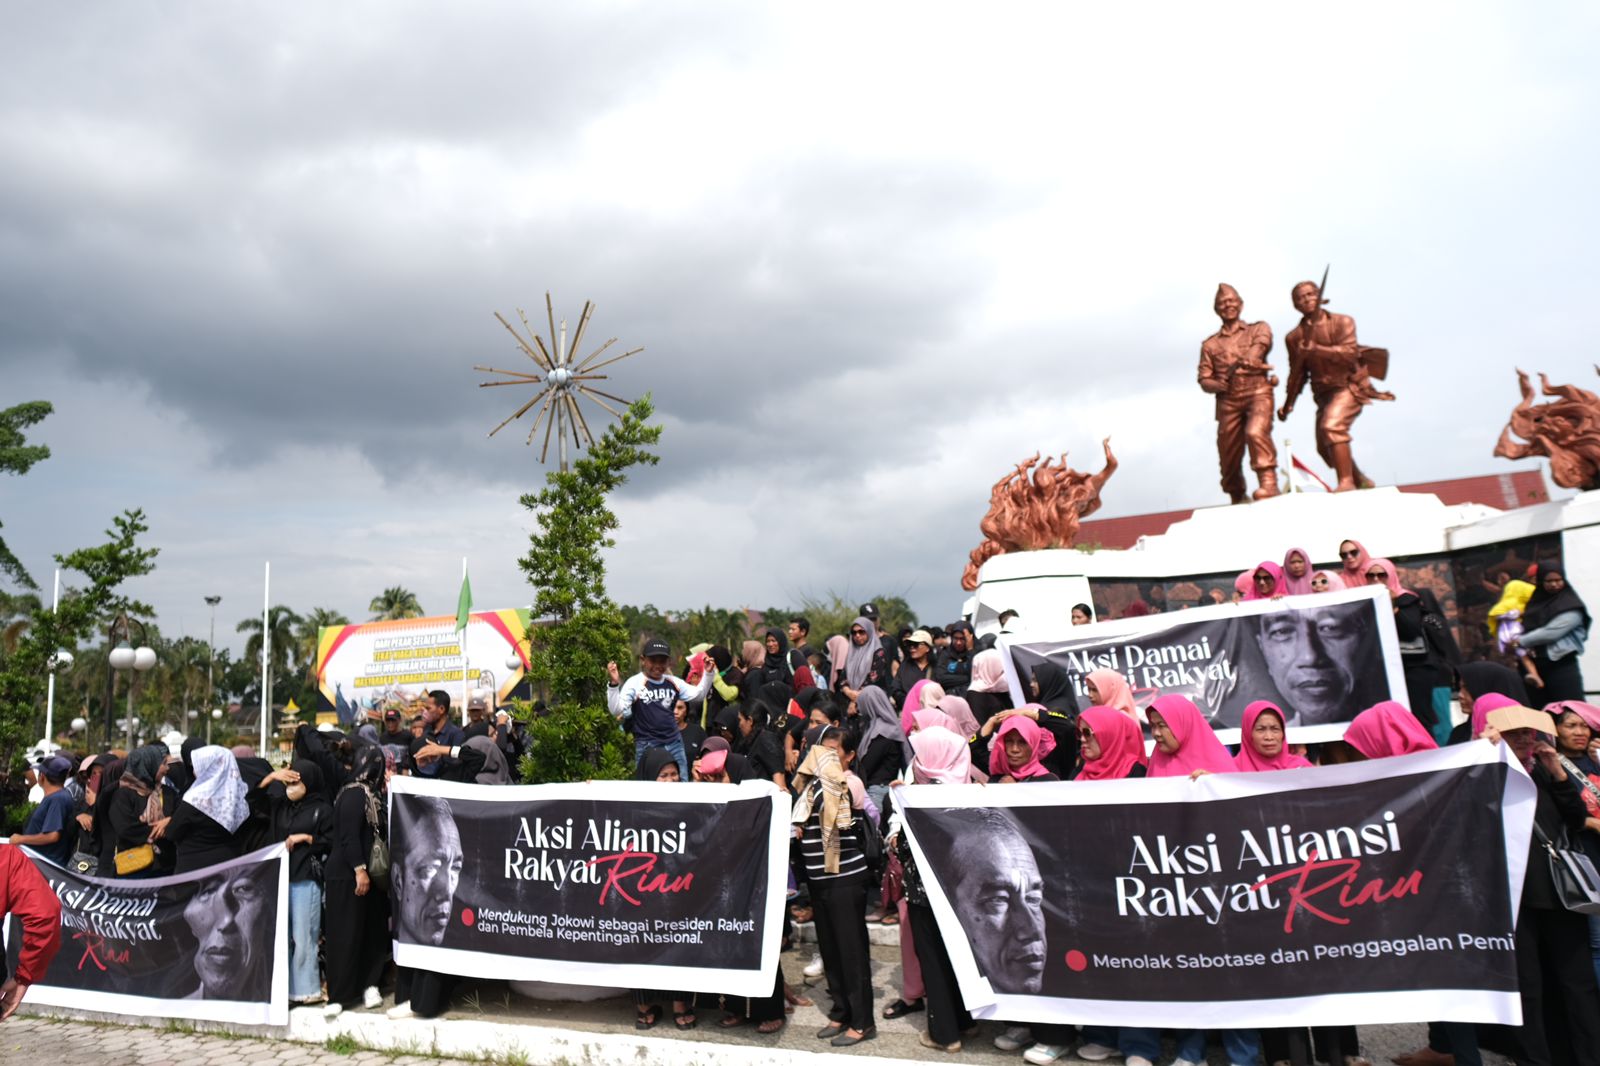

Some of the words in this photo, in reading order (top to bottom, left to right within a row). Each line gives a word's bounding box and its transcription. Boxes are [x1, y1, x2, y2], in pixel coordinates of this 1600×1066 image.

[1066, 646, 1119, 675] Aksi
[1124, 636, 1211, 668] Damai
[1142, 659, 1236, 690] Rakyat
[514, 817, 573, 850] Aksi
[581, 819, 687, 854] Aliansi
[1129, 833, 1222, 875] Aksi
[1237, 811, 1401, 871] Aliansi
[504, 848, 601, 891] Rakyat
[585, 842, 694, 906] Riau
[1115, 874, 1280, 925] Rakyat
[1250, 849, 1423, 934] Riau
[49, 879, 90, 909] ksi
[83, 888, 159, 917] Damai
[91, 912, 162, 946] Rakyat
[477, 920, 499, 933] dan
[501, 922, 553, 939] Pembela
[556, 927, 639, 946] Kepentingan
[643, 931, 703, 944] Nasional.
[478, 907, 547, 927] Mendukung
[551, 914, 594, 929] Jokowi
[598, 917, 649, 933] sebagai
[654, 917, 713, 931] Presiden
[718, 918, 755, 934] Rakyat
[1093, 953, 1173, 970] Menolak
[1176, 953, 1266, 970] Sabotase
[1270, 947, 1310, 965] dan
[1313, 934, 1454, 960] Penggagalan
